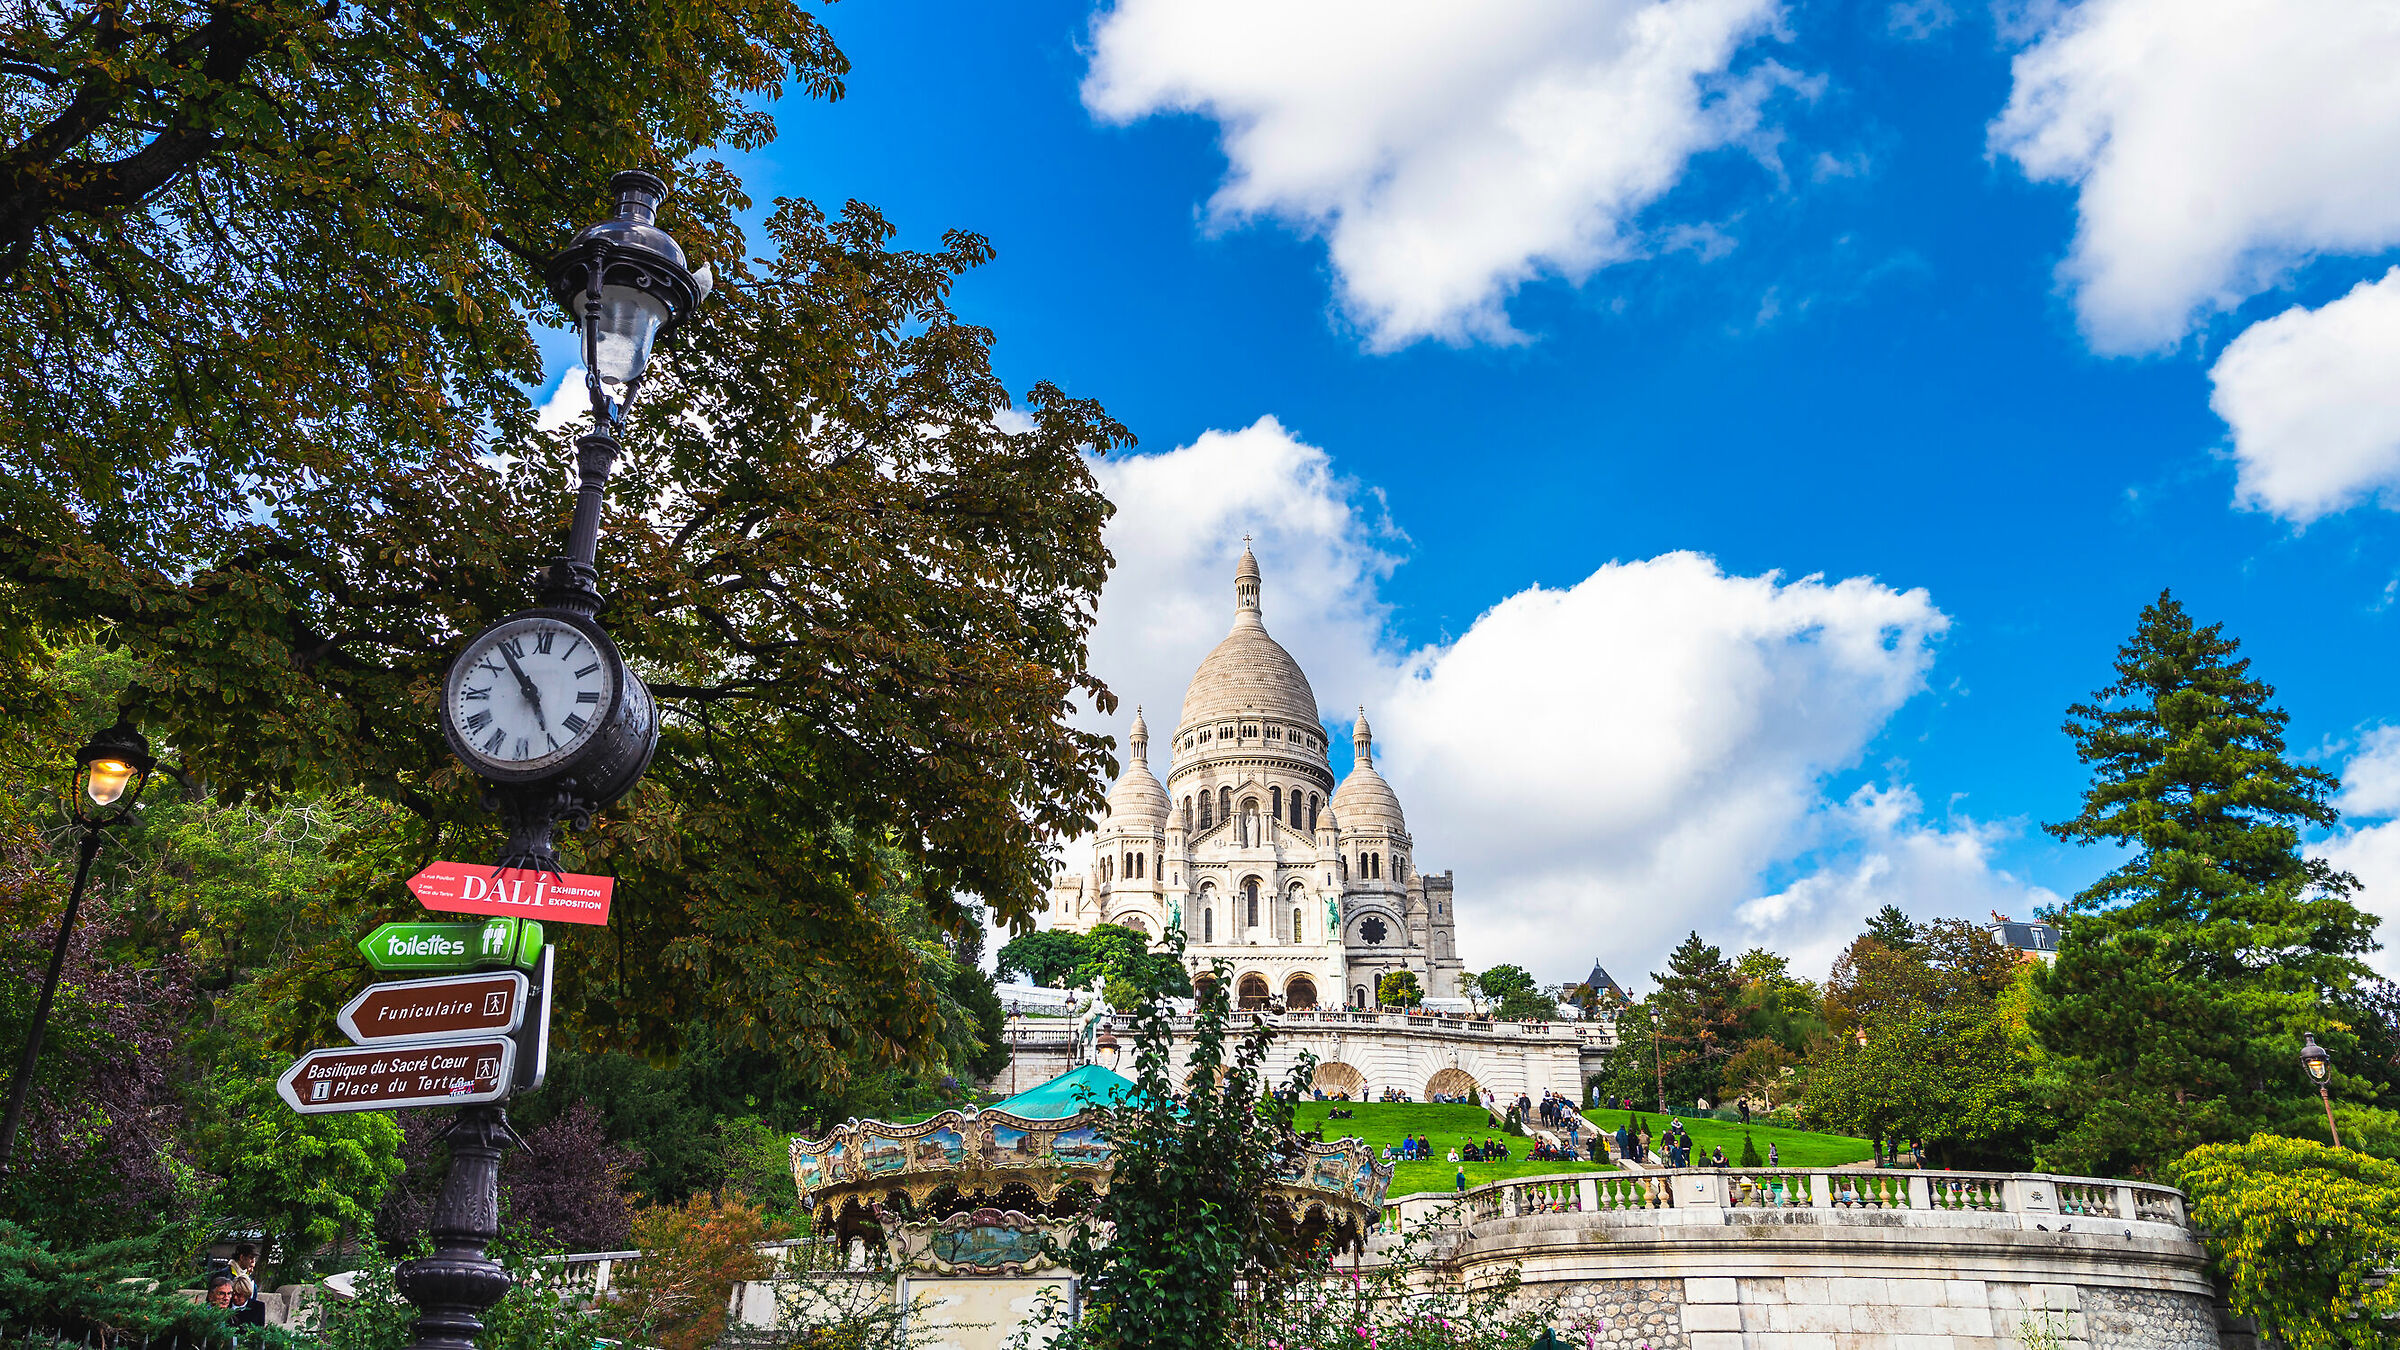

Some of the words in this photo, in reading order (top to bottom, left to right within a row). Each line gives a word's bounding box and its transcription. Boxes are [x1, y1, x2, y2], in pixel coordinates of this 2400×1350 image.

[533, 632, 555, 654] XII
[562, 640, 580, 661] I
[479, 657, 505, 678] X
[574, 662, 599, 679] II
[576, 691, 600, 704] III
[459, 873, 547, 907] DALÍ
[550, 886, 601, 898] EXHIBITION
[548, 898, 602, 910] EXPOSITION
[387, 934, 465, 956] toilettes
[377, 1000, 473, 1021] Funiculaire
[307, 1062, 368, 1080] Basilique
[370, 1060, 388, 1075] du
[389, 1056, 429, 1073] Sacré
[431, 1055, 470, 1069] Cœur
[333, 1081, 379, 1097] Place
[388, 1078, 408, 1093] du
